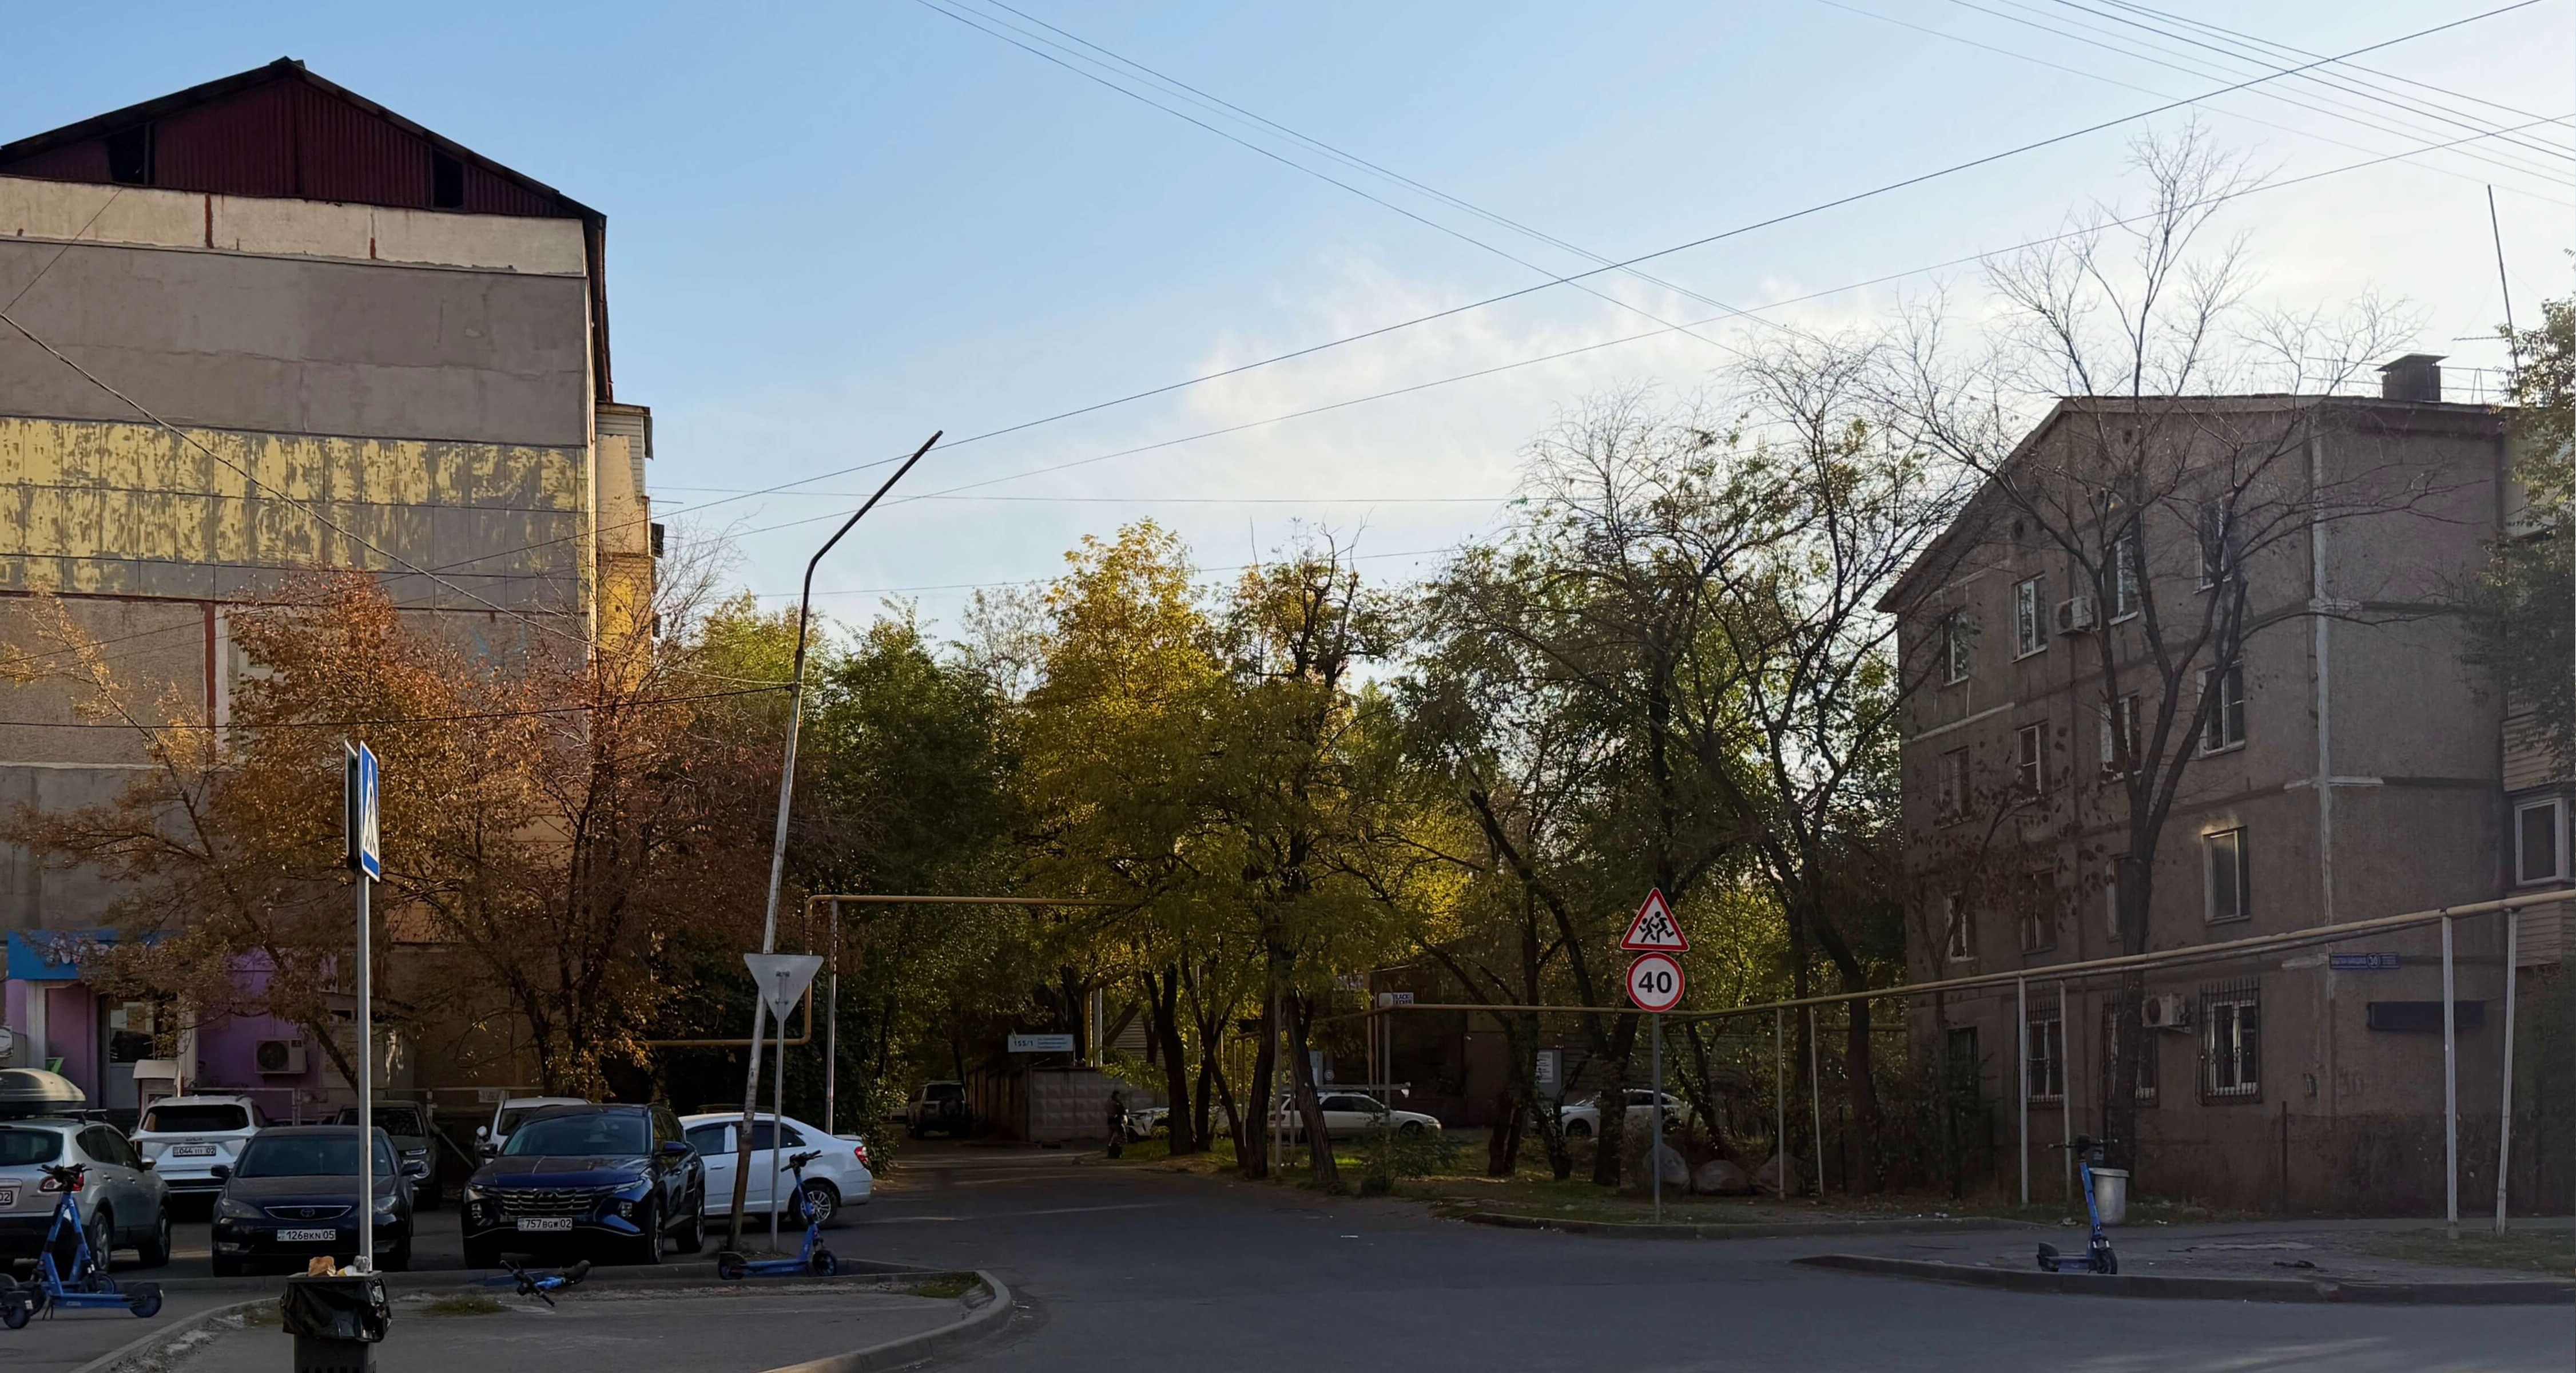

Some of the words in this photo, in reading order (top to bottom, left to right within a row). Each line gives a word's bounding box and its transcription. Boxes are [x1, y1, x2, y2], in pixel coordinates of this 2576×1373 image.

[1638, 971, 1672, 994] 40
[560, 1219, 571, 1228] 02
[323, 1230, 335, 1239] 05
